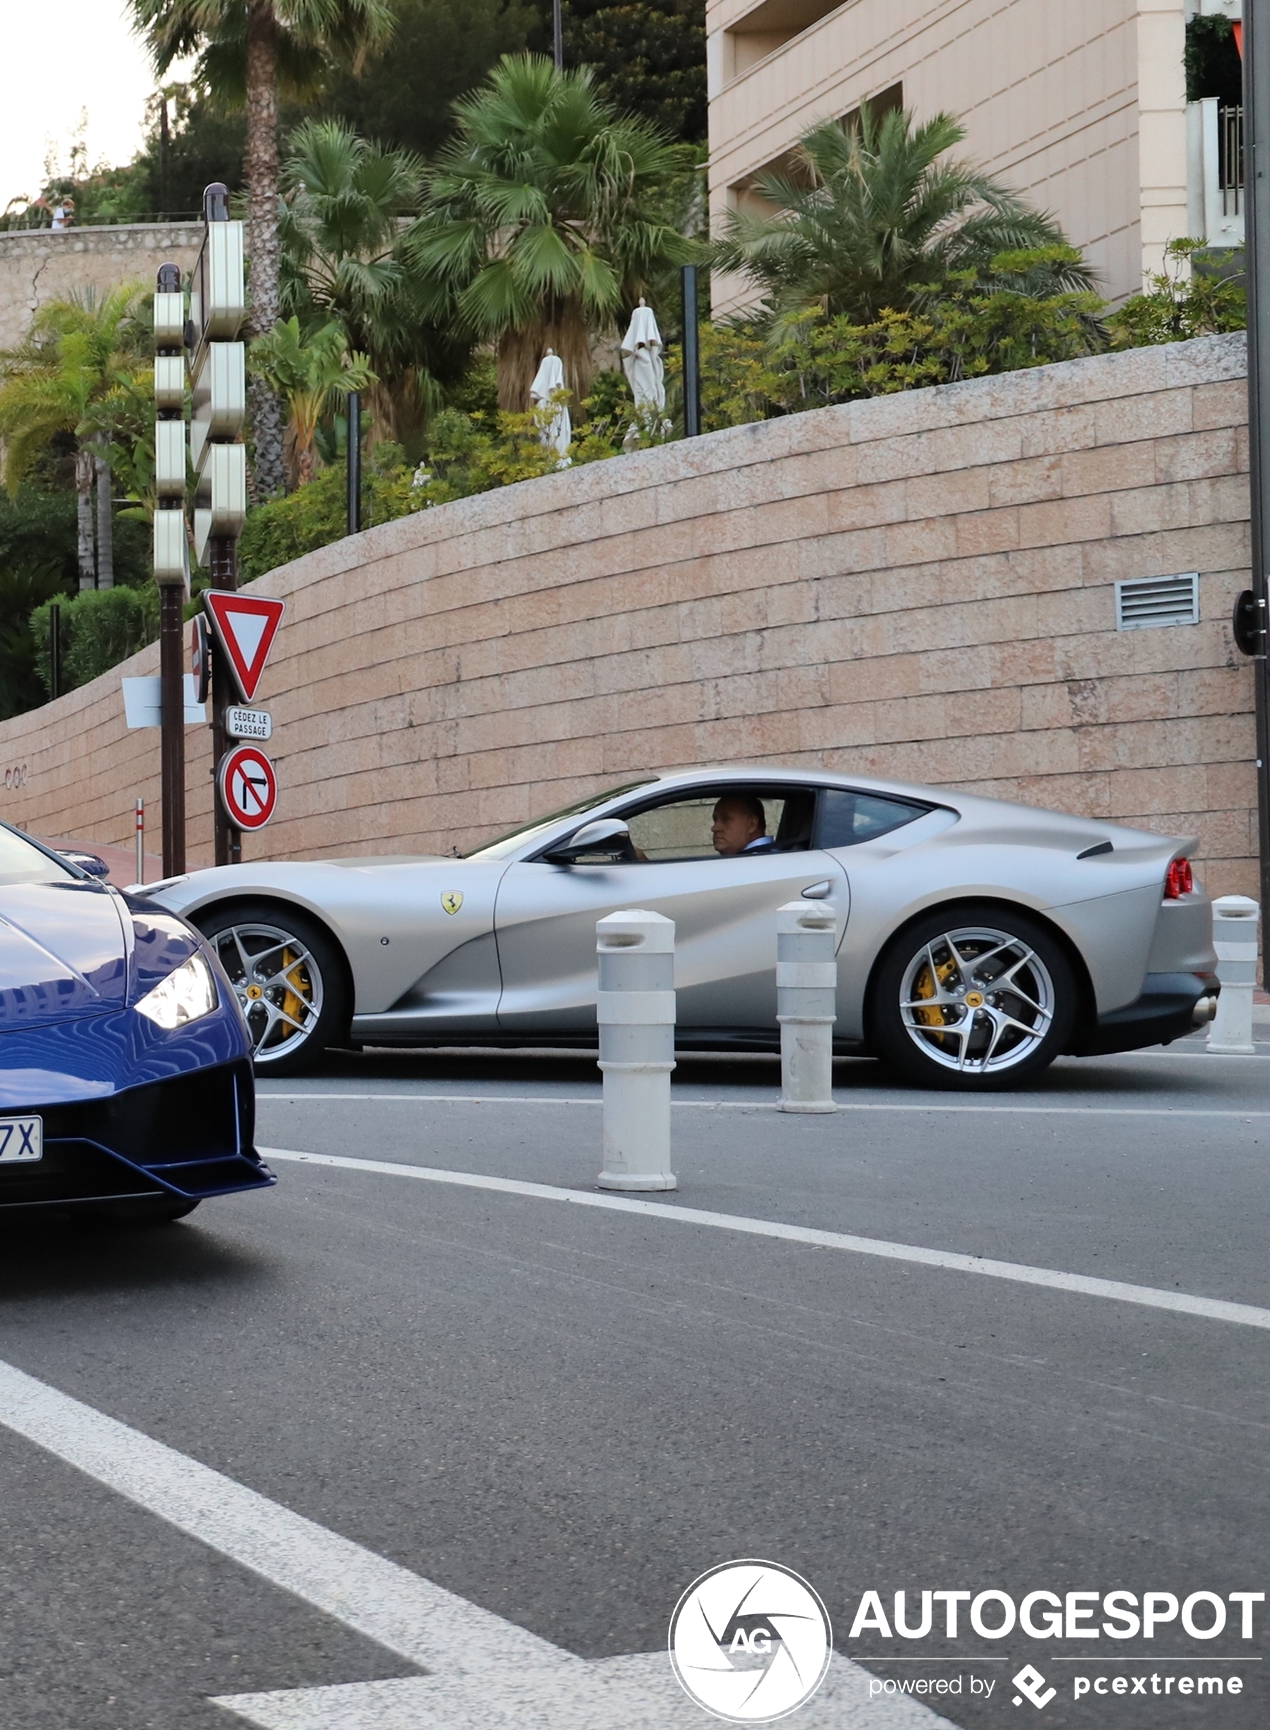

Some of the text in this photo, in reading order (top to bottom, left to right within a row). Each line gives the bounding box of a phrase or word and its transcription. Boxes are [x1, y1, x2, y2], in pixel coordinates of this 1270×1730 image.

[234, 710, 267, 725] CÉDEZ LE
[235, 723, 266, 736] PASSAGE
